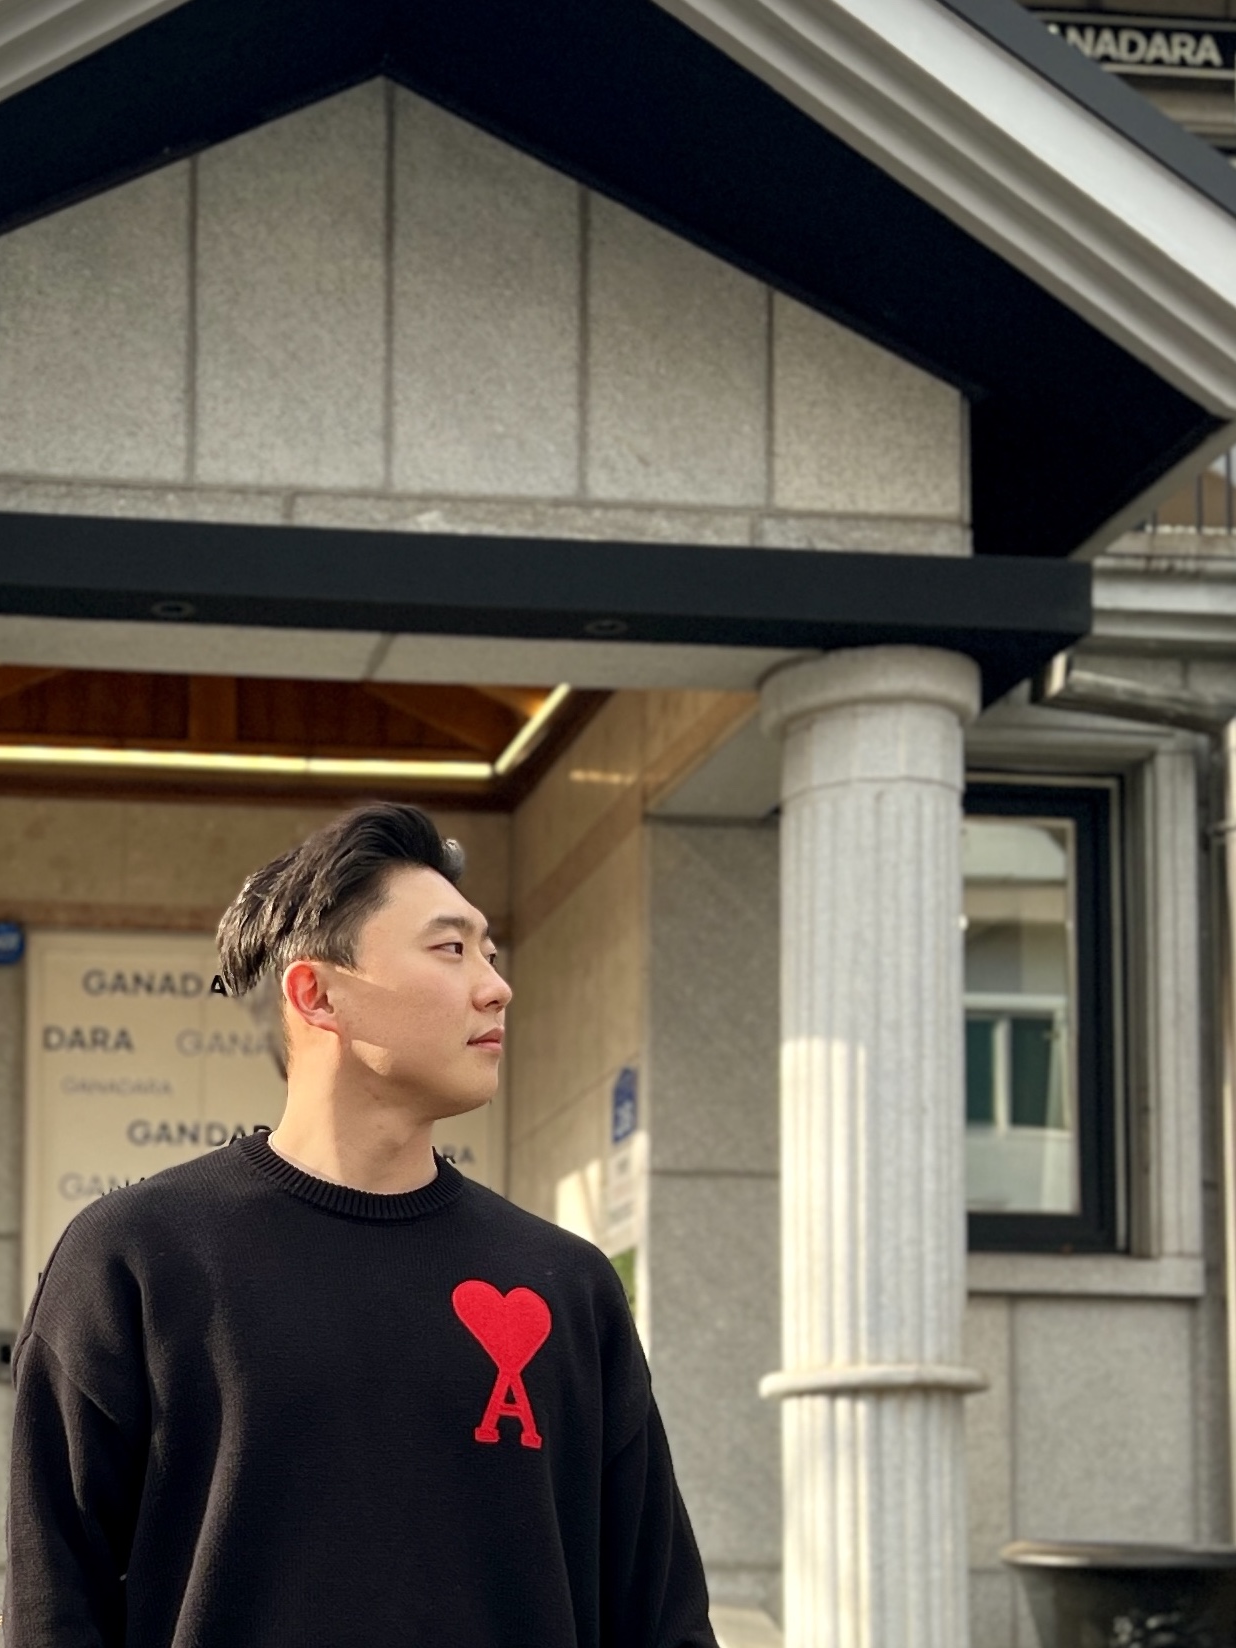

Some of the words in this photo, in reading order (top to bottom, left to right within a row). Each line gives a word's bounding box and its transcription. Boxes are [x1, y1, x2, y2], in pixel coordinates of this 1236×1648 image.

[1048, 24, 1223, 67] NADARA
[43, 1025, 135, 1053] DARA
[127, 1119, 272, 1147] GANDA
